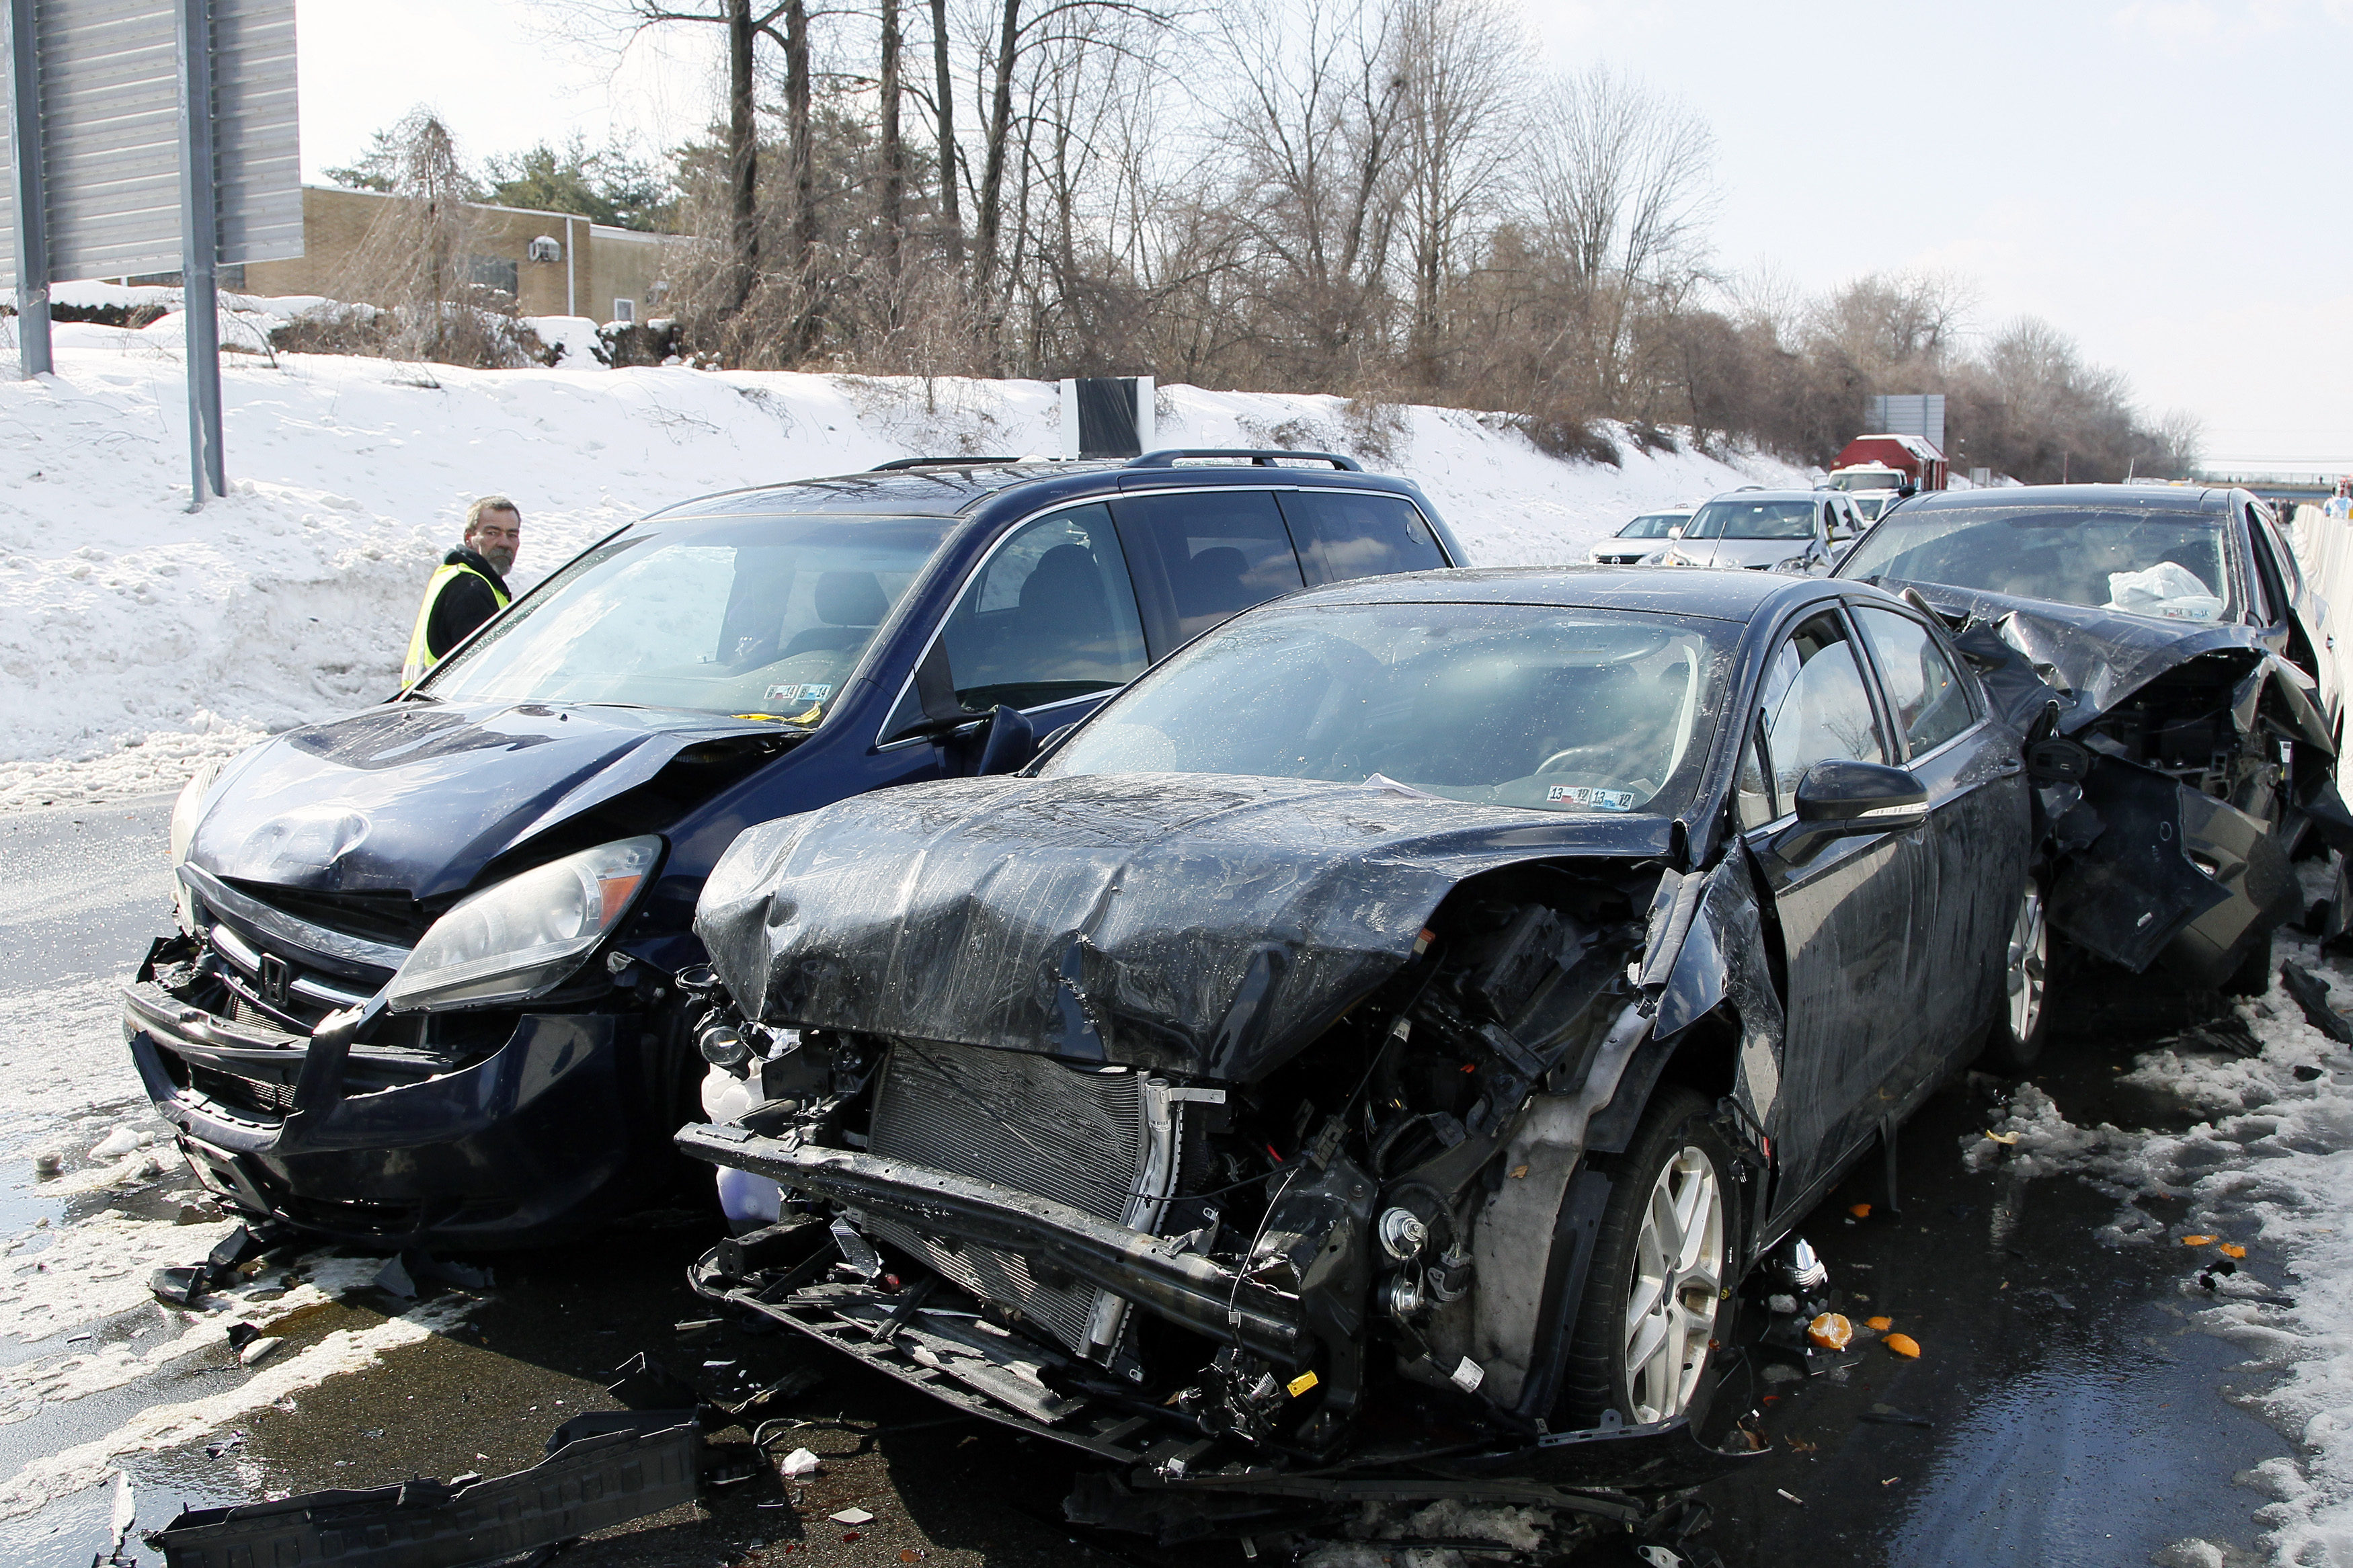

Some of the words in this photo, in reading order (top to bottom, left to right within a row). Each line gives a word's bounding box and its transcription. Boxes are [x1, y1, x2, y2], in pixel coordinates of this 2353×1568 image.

[767, 688, 774, 698] 6
[784, 686, 796, 697] 14
[799, 688, 807, 698] 6
[816, 686, 828, 698] 14
[1550, 786, 1564, 800] 13
[1577, 788, 1589, 801] 12
[1592, 790, 1605, 805] 13
[1618, 793, 1632, 807] 12
